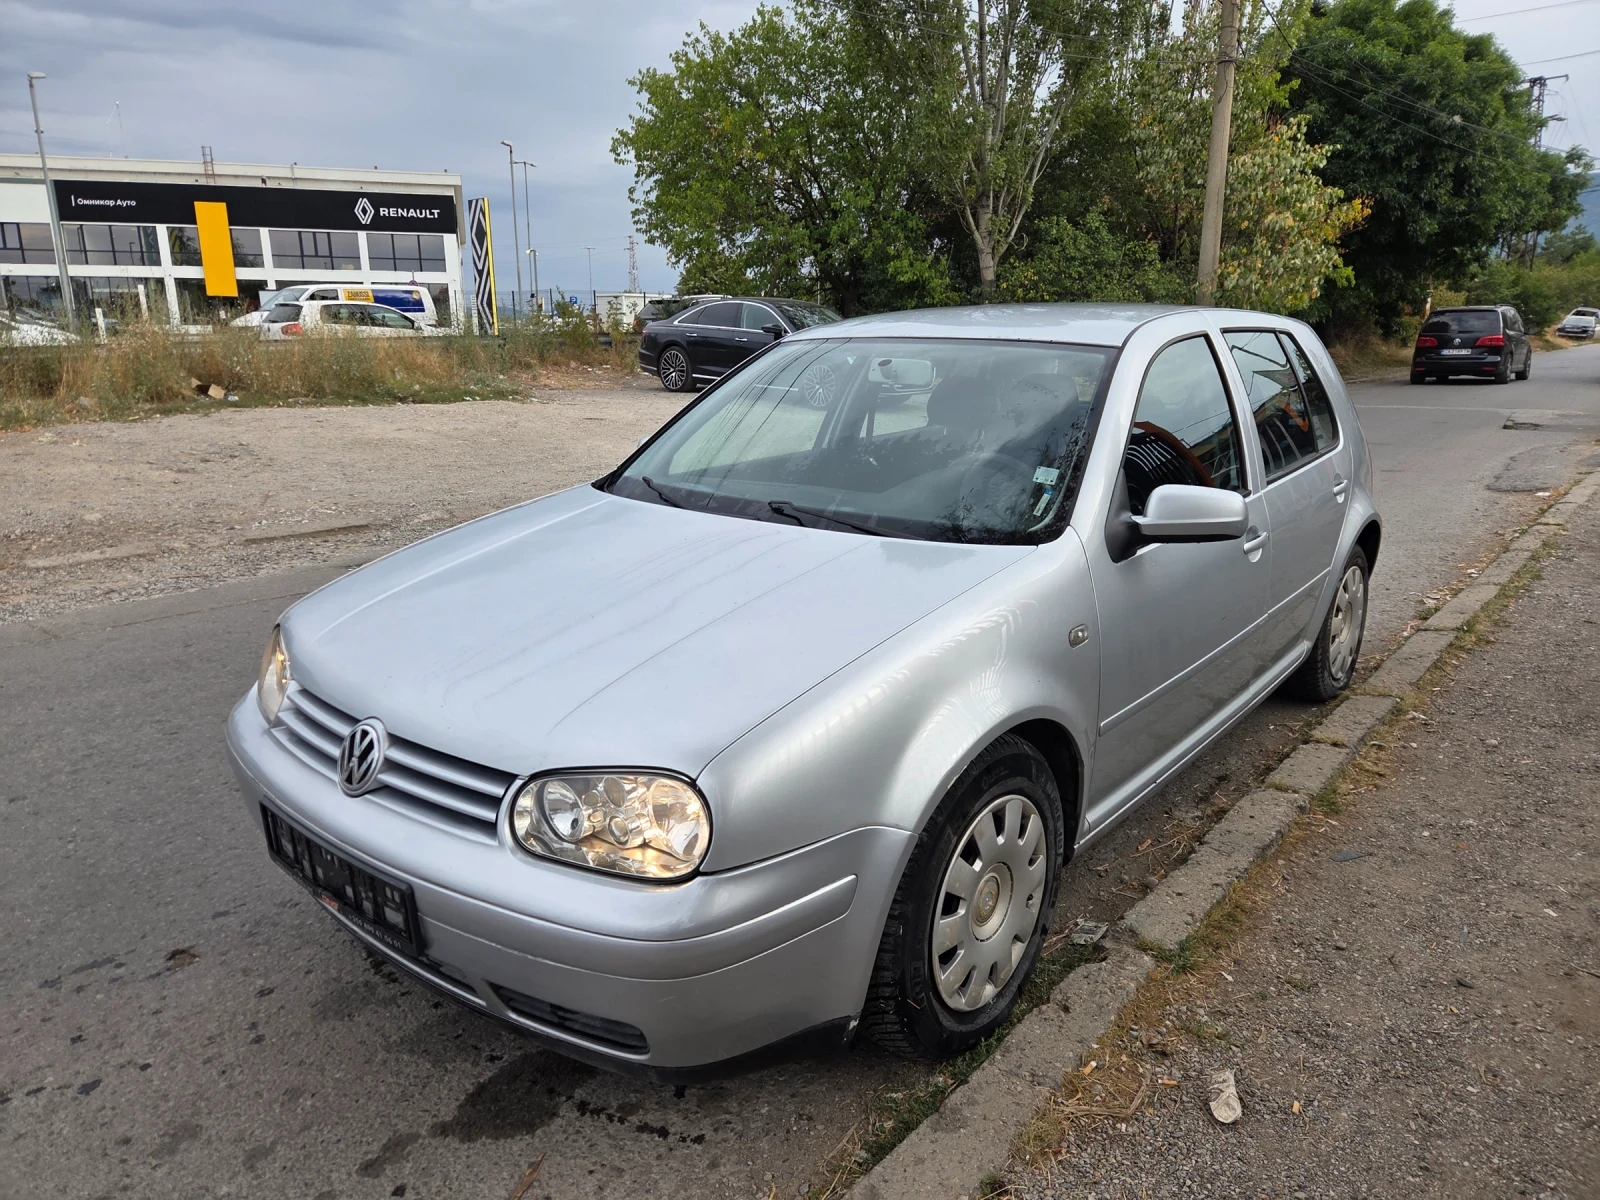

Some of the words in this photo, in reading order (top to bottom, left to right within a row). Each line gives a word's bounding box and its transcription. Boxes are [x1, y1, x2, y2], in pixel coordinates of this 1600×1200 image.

[77, 198, 115, 207] Омникар
[116, 199, 136, 208] Ауто
[379, 207, 440, 219] RENAULT
